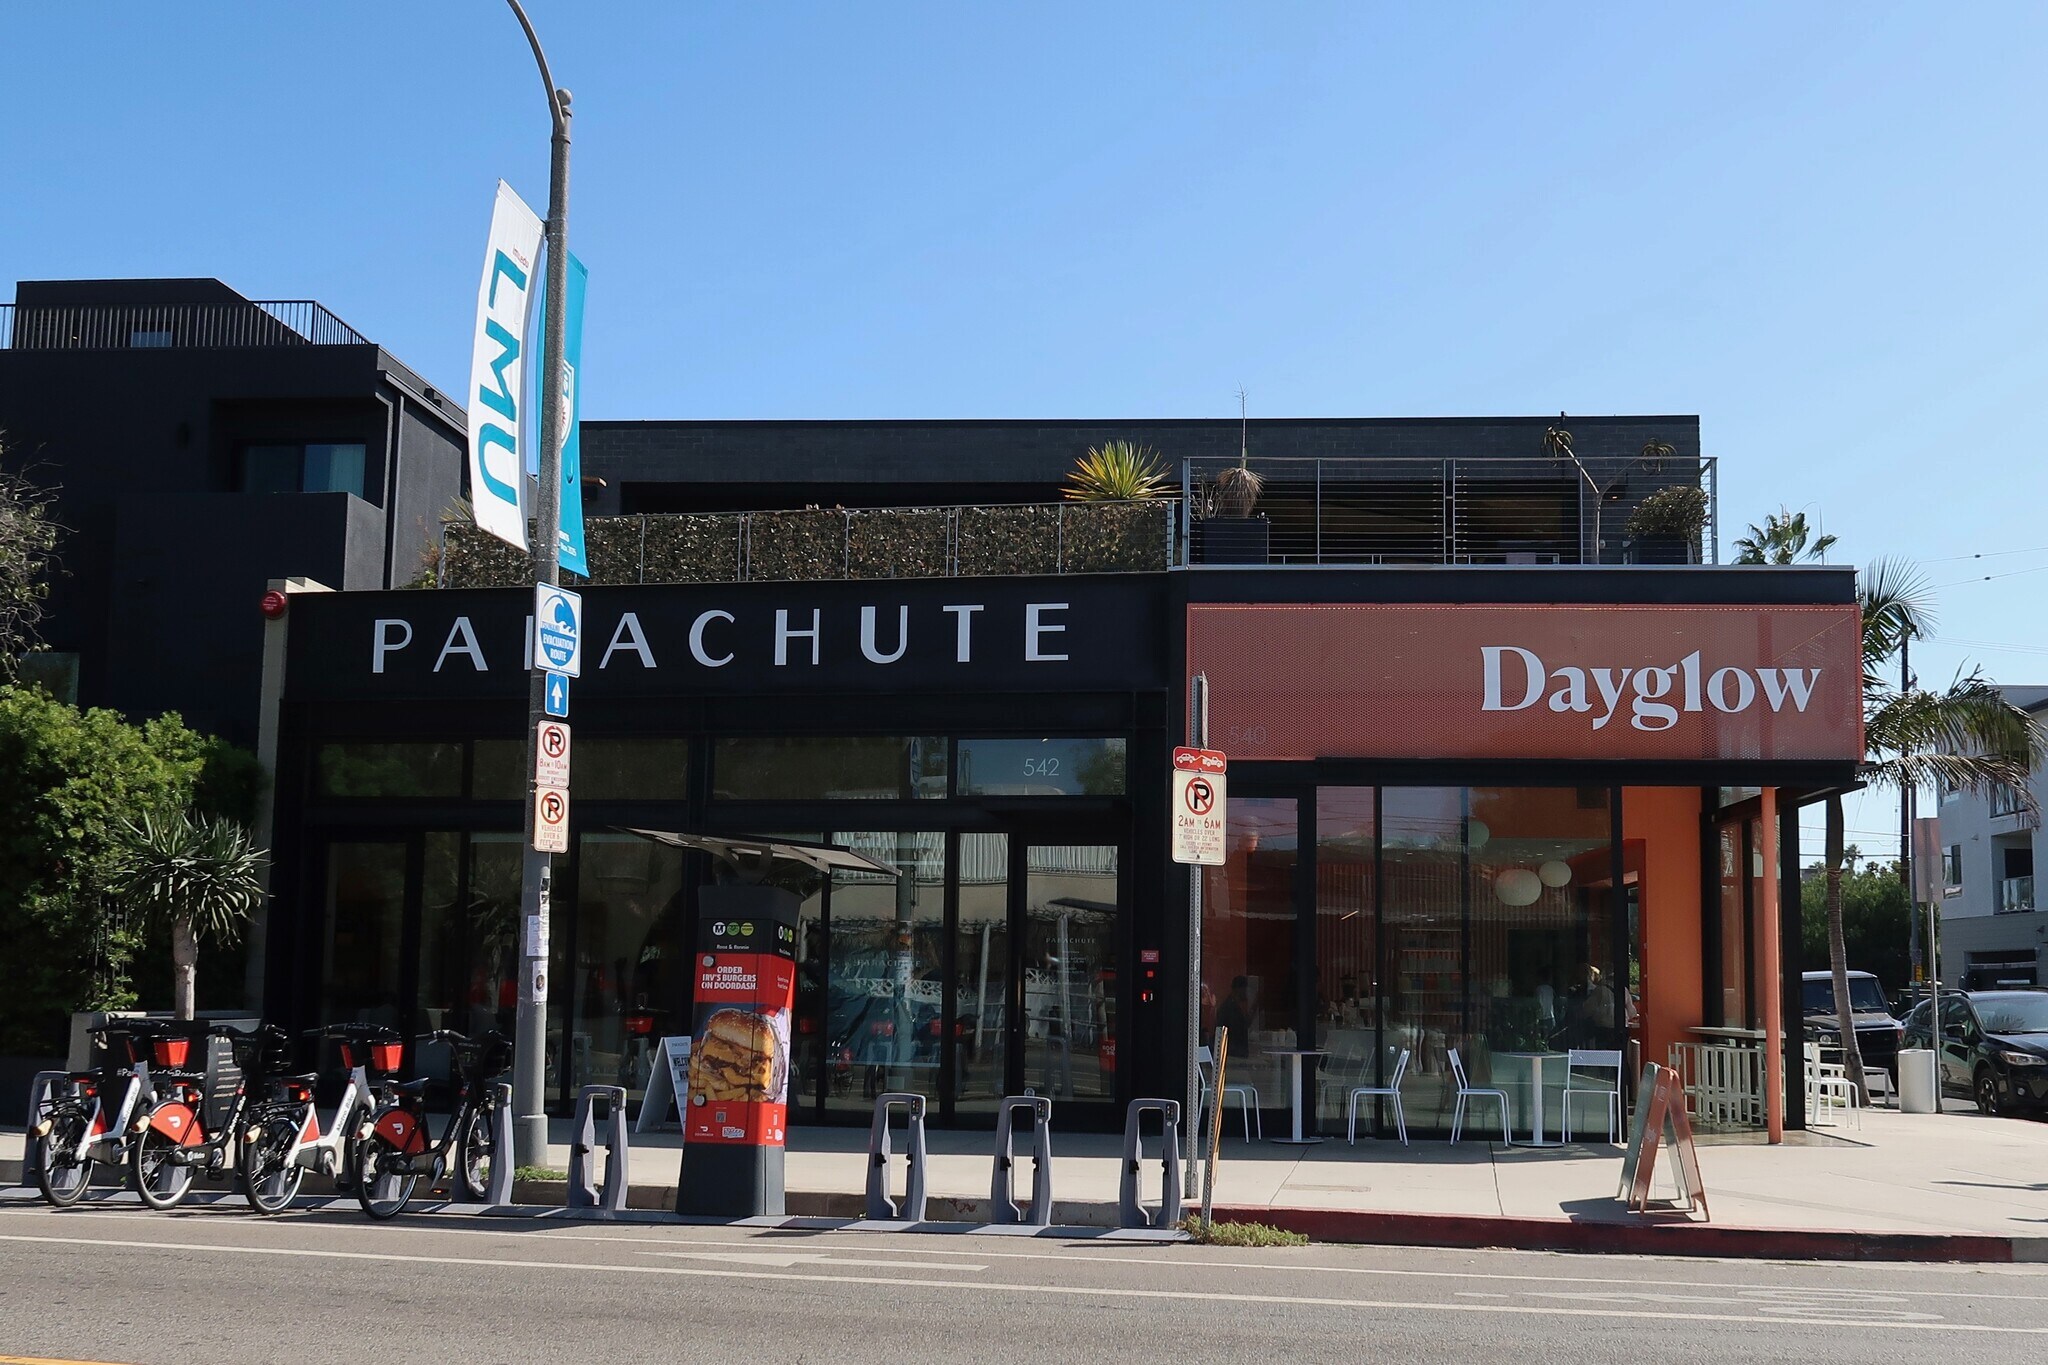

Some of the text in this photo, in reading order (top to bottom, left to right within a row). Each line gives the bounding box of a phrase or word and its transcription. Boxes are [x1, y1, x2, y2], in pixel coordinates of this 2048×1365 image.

[478, 247, 527, 507] LMU
[543, 633, 574, 651] EVACUATION
[1480, 645, 1822, 732] Dayglow
[1022, 758, 1060, 777] 542
[1178, 814, 1194, 828] 2AM
[1204, 817, 1220, 829] 6AM
[336, 1110, 347, 1131] Metro
